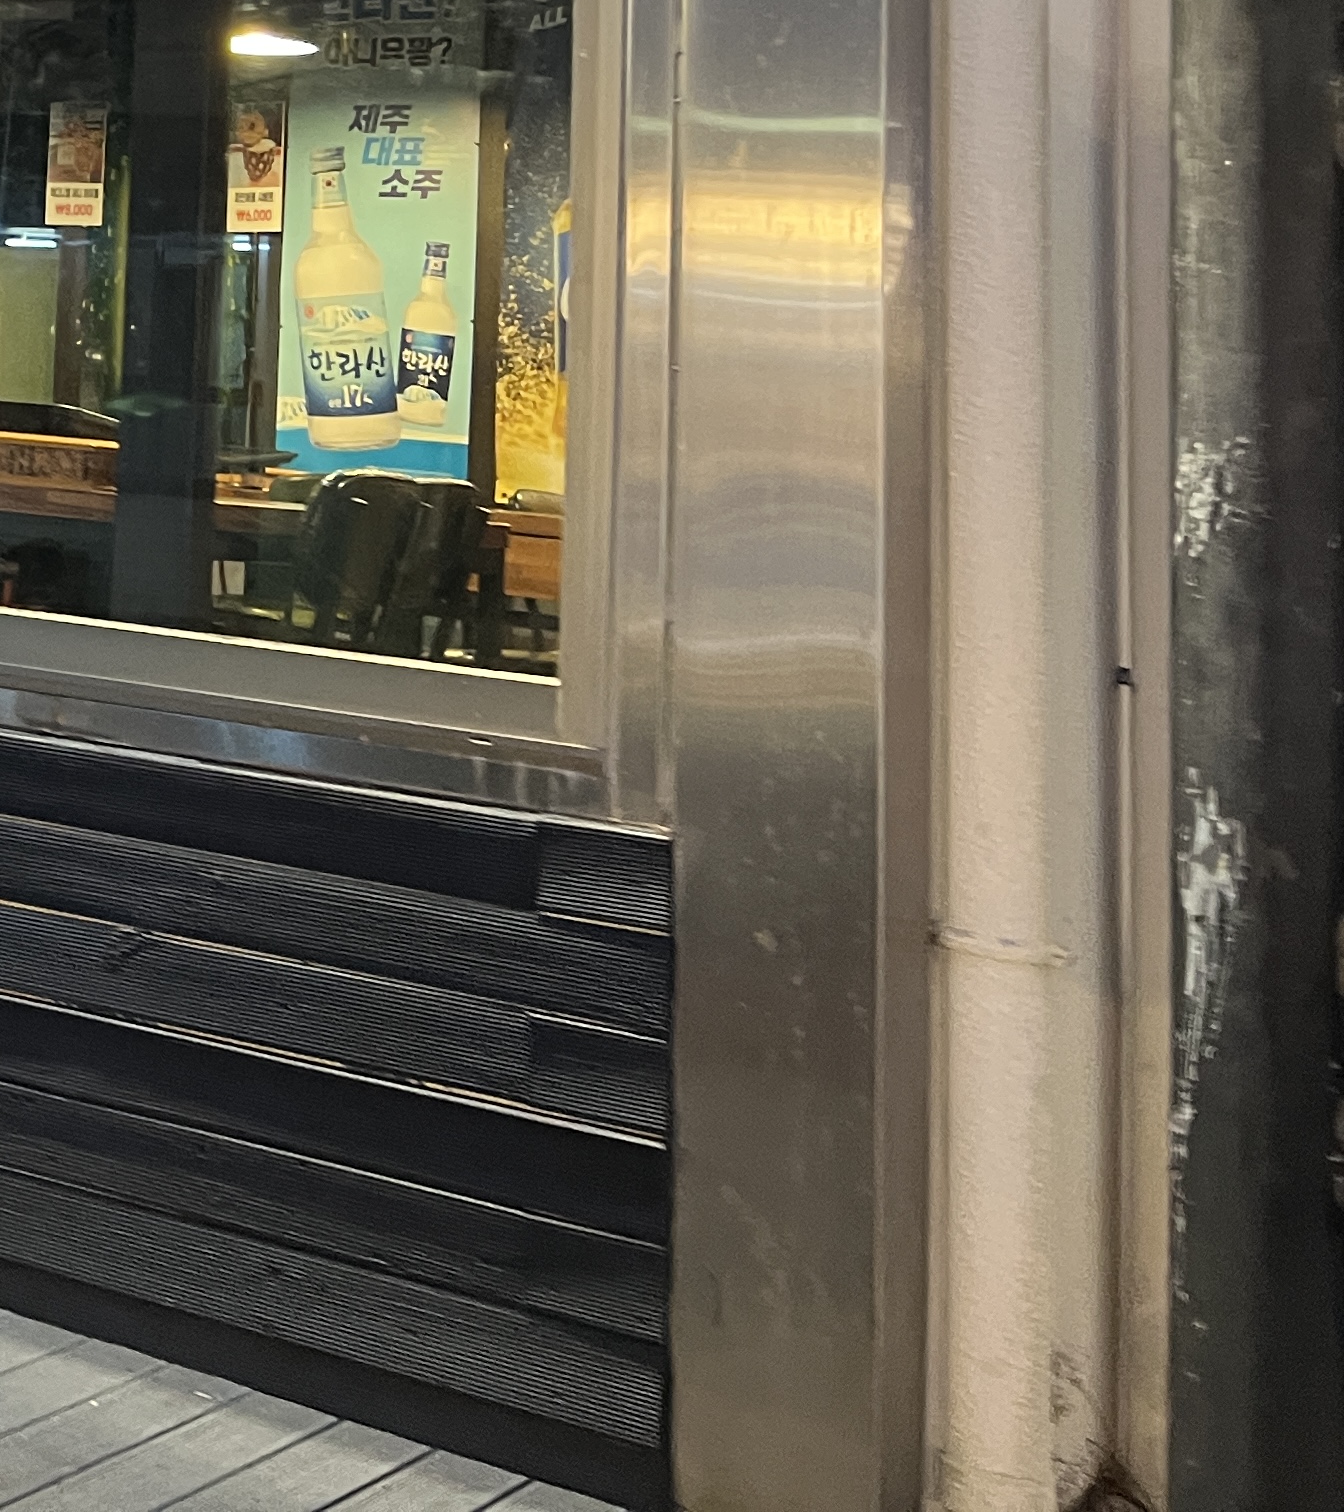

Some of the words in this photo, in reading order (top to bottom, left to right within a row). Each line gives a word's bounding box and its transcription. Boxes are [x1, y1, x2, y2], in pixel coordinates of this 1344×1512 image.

[348, 103, 412, 134] 제주
[362, 136, 426, 166] 대표
[378, 169, 444, 199] 소주
[307, 345, 387, 382] 한라산
[401, 347, 450, 376] 한라산
